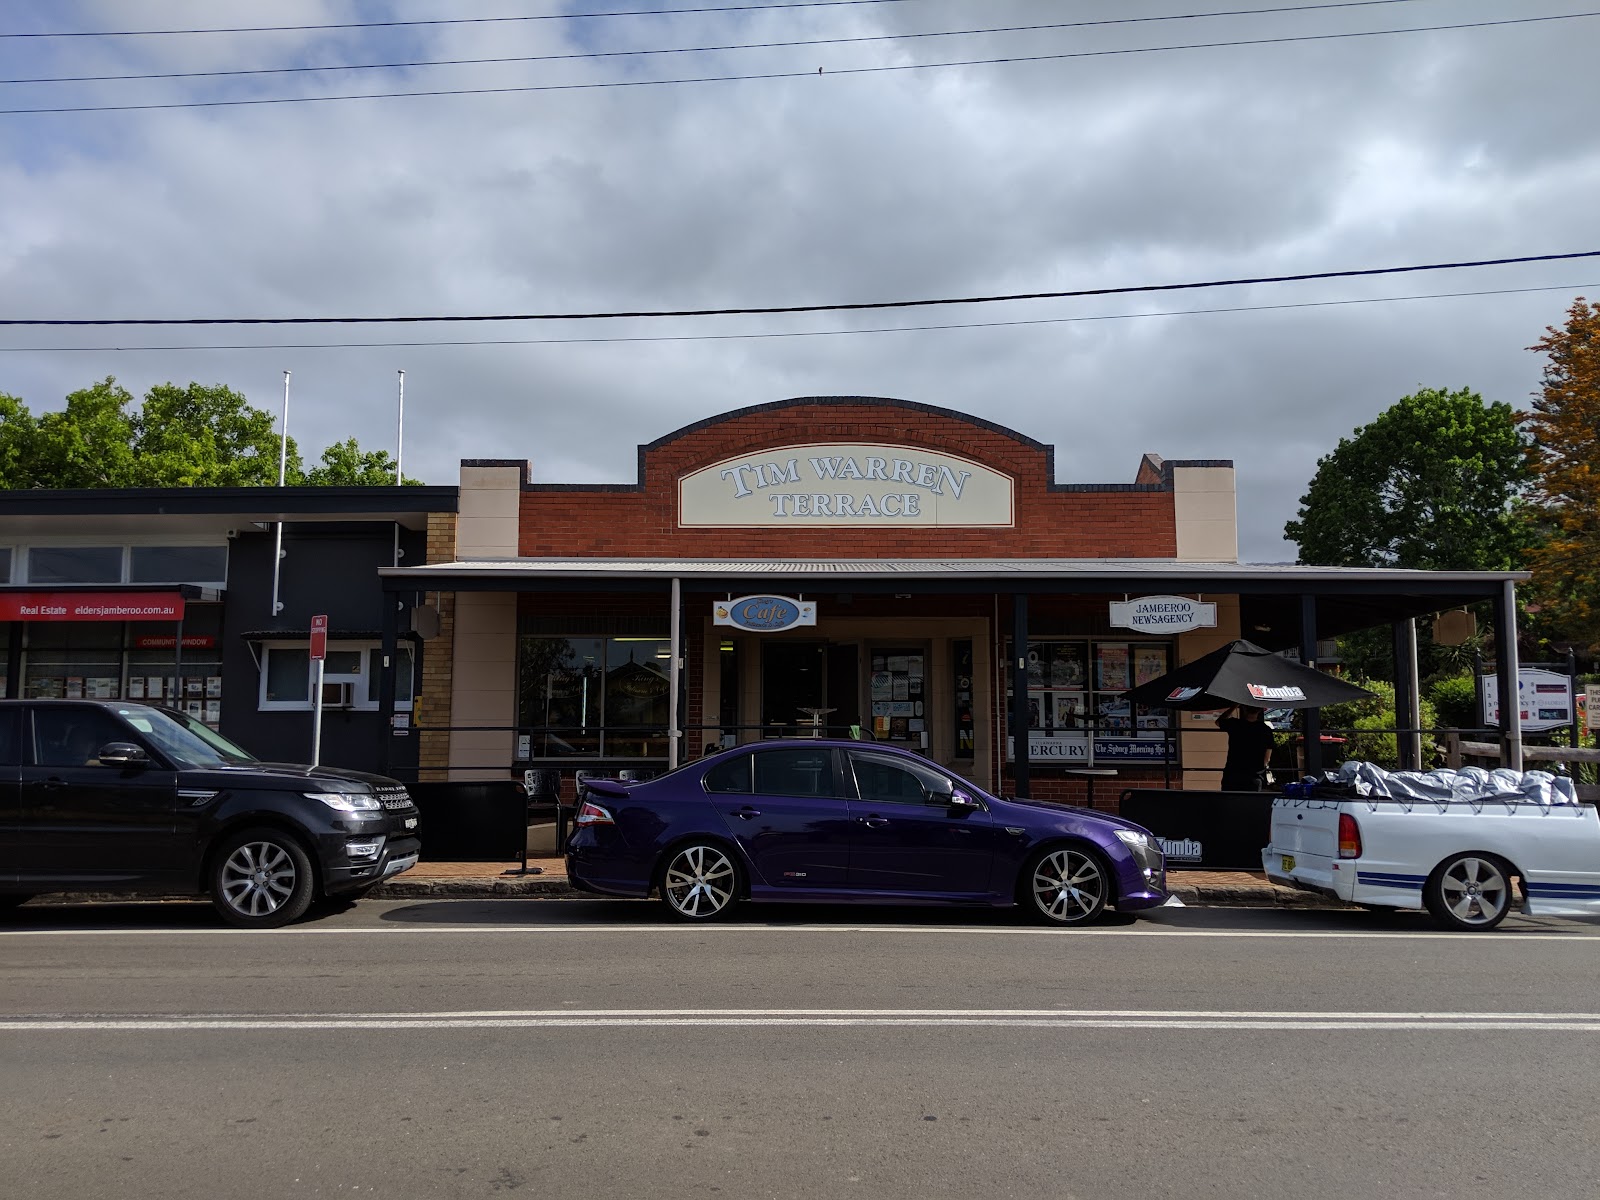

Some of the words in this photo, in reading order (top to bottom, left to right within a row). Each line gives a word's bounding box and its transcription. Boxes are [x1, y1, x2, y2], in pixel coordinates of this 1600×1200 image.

[720, 457, 801, 499] TIM
[808, 456, 972, 500] WARREN
[769, 493, 921, 518] TERRACE
[20, 605, 39, 615] Real
[40, 605, 67, 615] Estate
[75, 605, 175, 617] eldersjamberoo.com.au
[743, 604, 788, 623] Cafe
[1135, 603, 1191, 614] JAMBEROO
[315, 618, 323, 626] NO
[1132, 612, 1195, 625] NEWSAGENCY
[142, 638, 178, 646] COMMUNIT
[181, 638, 208, 646] WINDOW
[1012, 745, 1087, 756] ERCURY
[1094, 743, 1106, 753] The
[1107, 743, 1128, 755] Sydney
[1129, 743, 1155, 756] Morning
[1154, 743, 1175, 755] Herld
